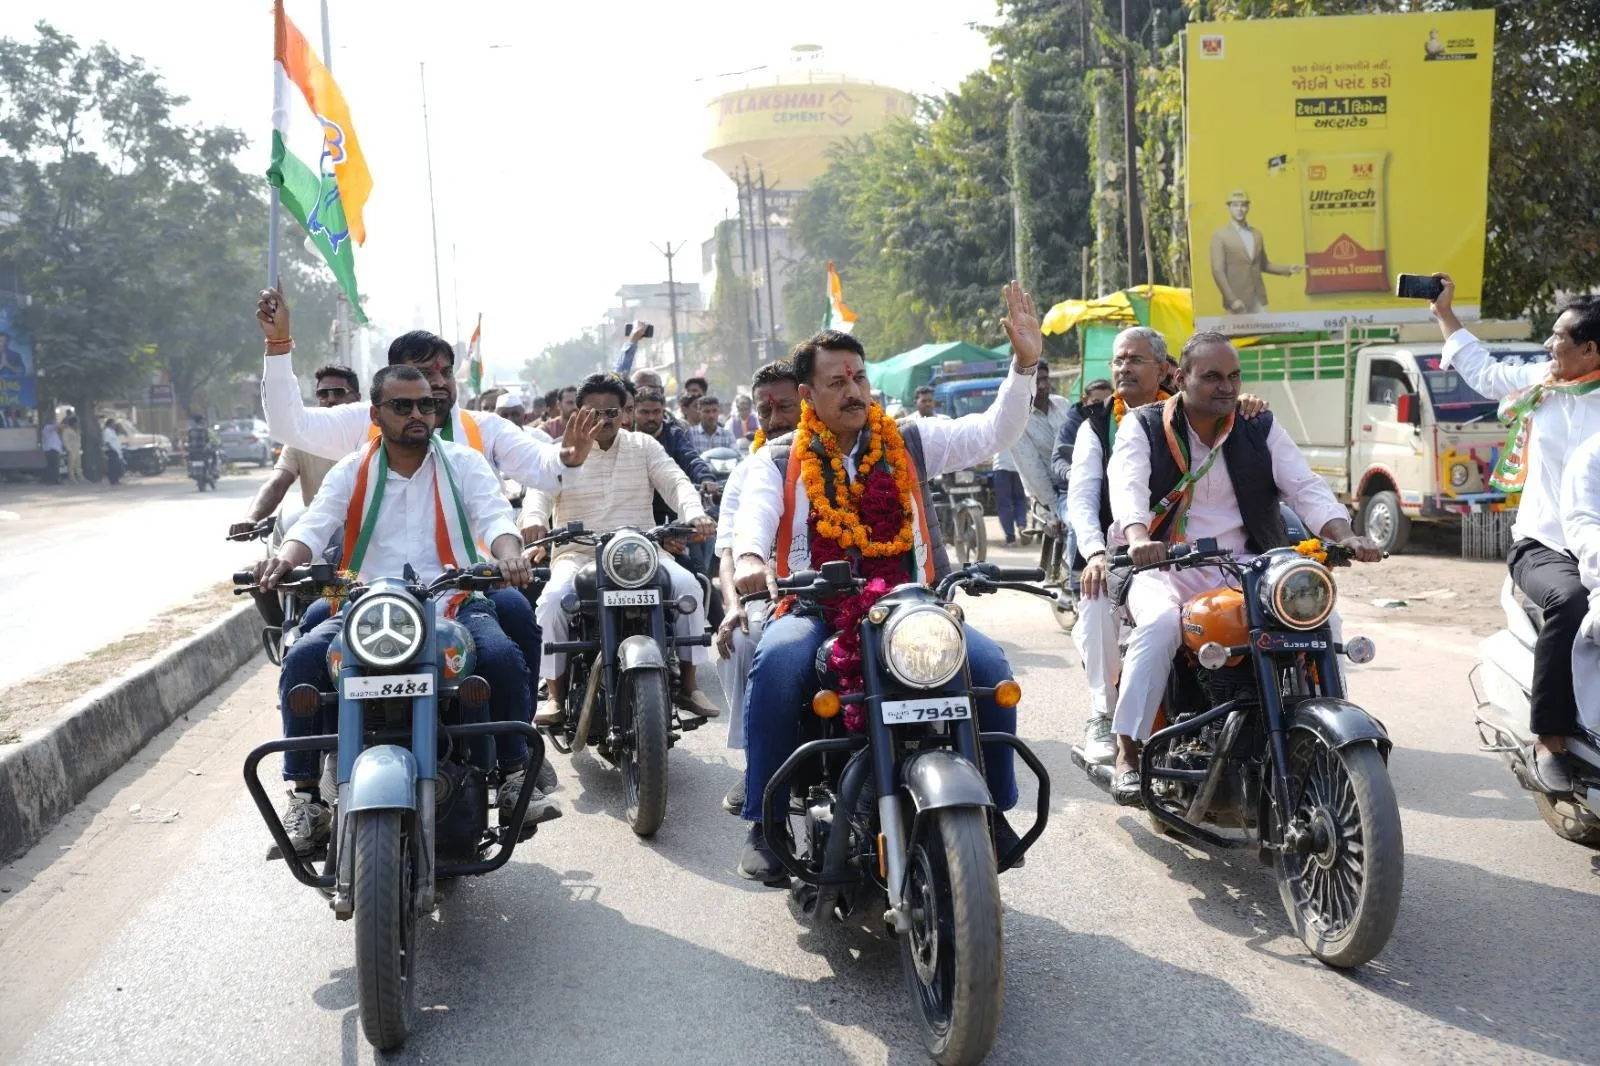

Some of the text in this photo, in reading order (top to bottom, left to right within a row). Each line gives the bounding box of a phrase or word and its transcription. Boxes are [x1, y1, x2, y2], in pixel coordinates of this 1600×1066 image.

[1334, 73, 1366, 89] પસંદ
[1371, 73, 1391, 89] કરો
[736, 92, 825, 113] LAKSHMI
[773, 112, 826, 123] CEMENT
[1309, 188, 1376, 202] UltraTech
[381, 682, 428, 696] 8484
[912, 706, 968, 720] 7949
